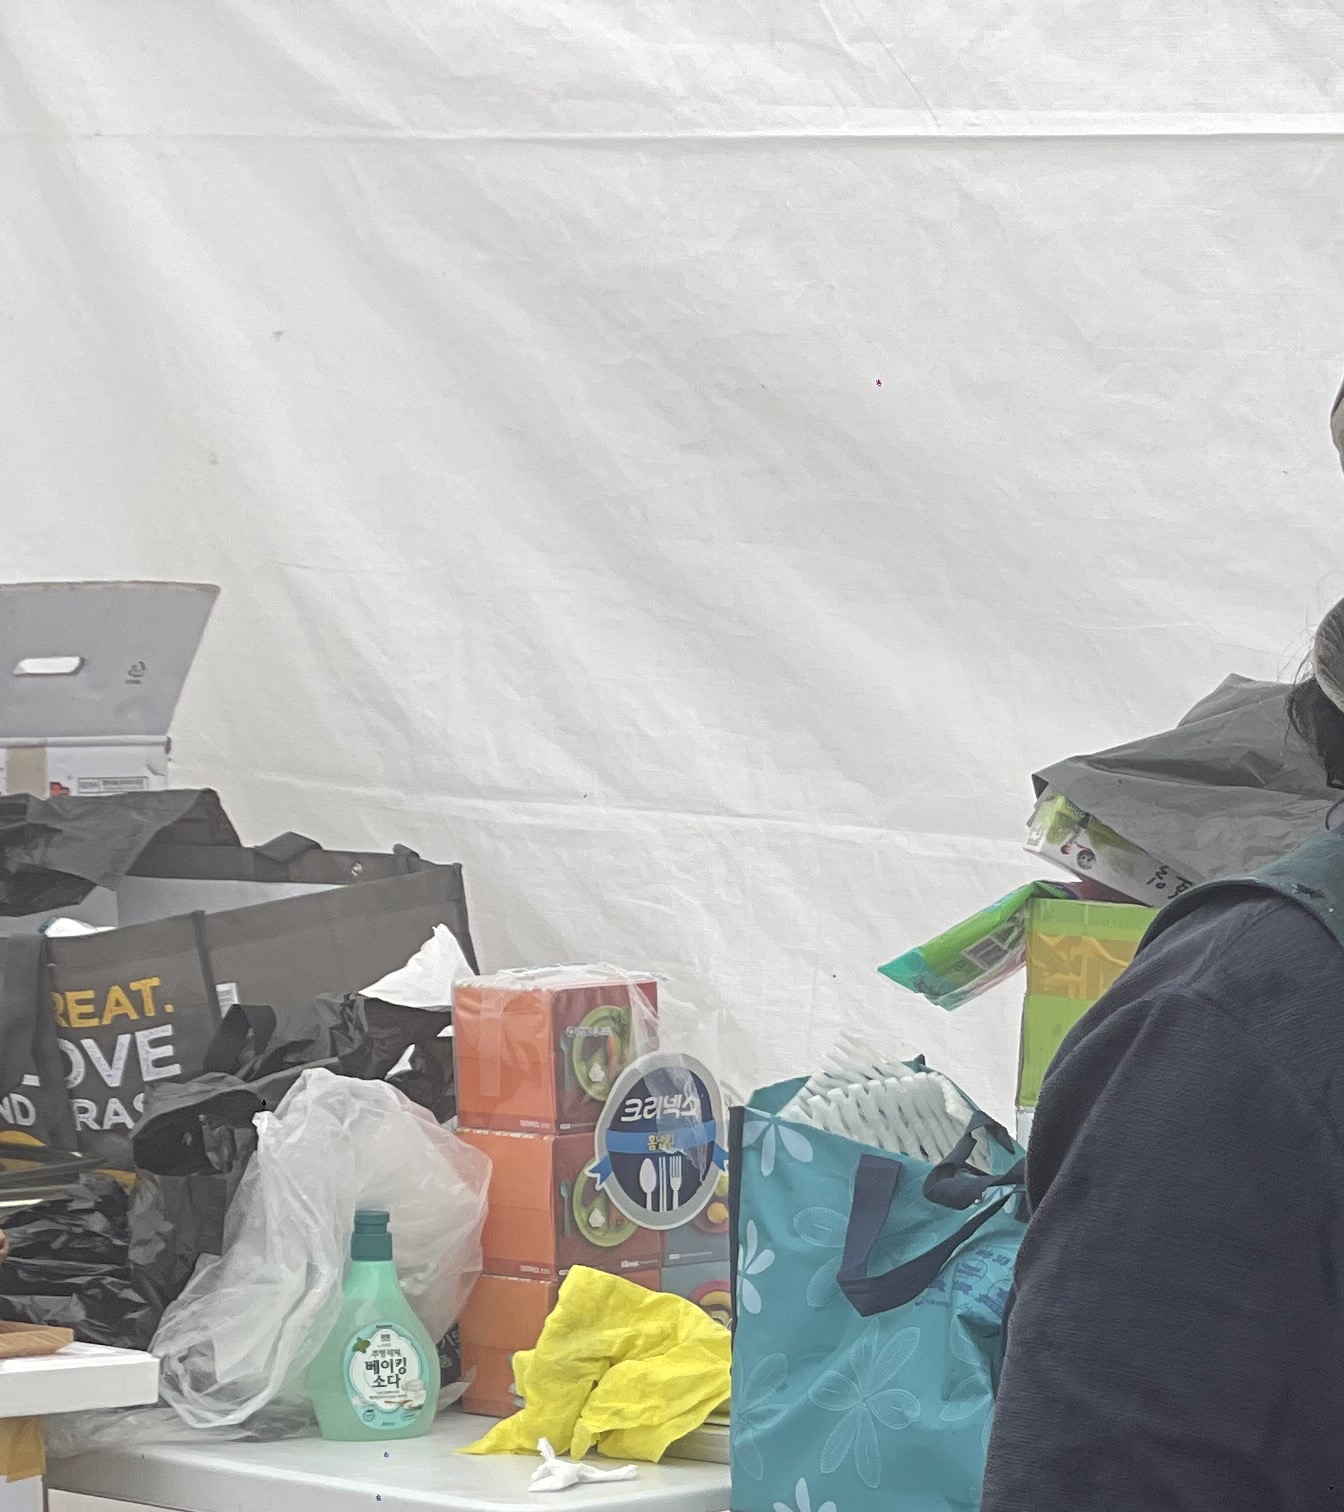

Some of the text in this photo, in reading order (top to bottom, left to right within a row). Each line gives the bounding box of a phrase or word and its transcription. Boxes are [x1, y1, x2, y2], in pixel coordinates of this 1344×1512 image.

[51, 976, 175, 1028] REAT.
[57, 1024, 181, 1089] OVE
[0, 1092, 145, 1132] ND RAS
[620, 1092, 702, 1123] 크리넥스
[365, 1357, 407, 1375] 베이킹
[371, 1374, 402, 1389] 소다
